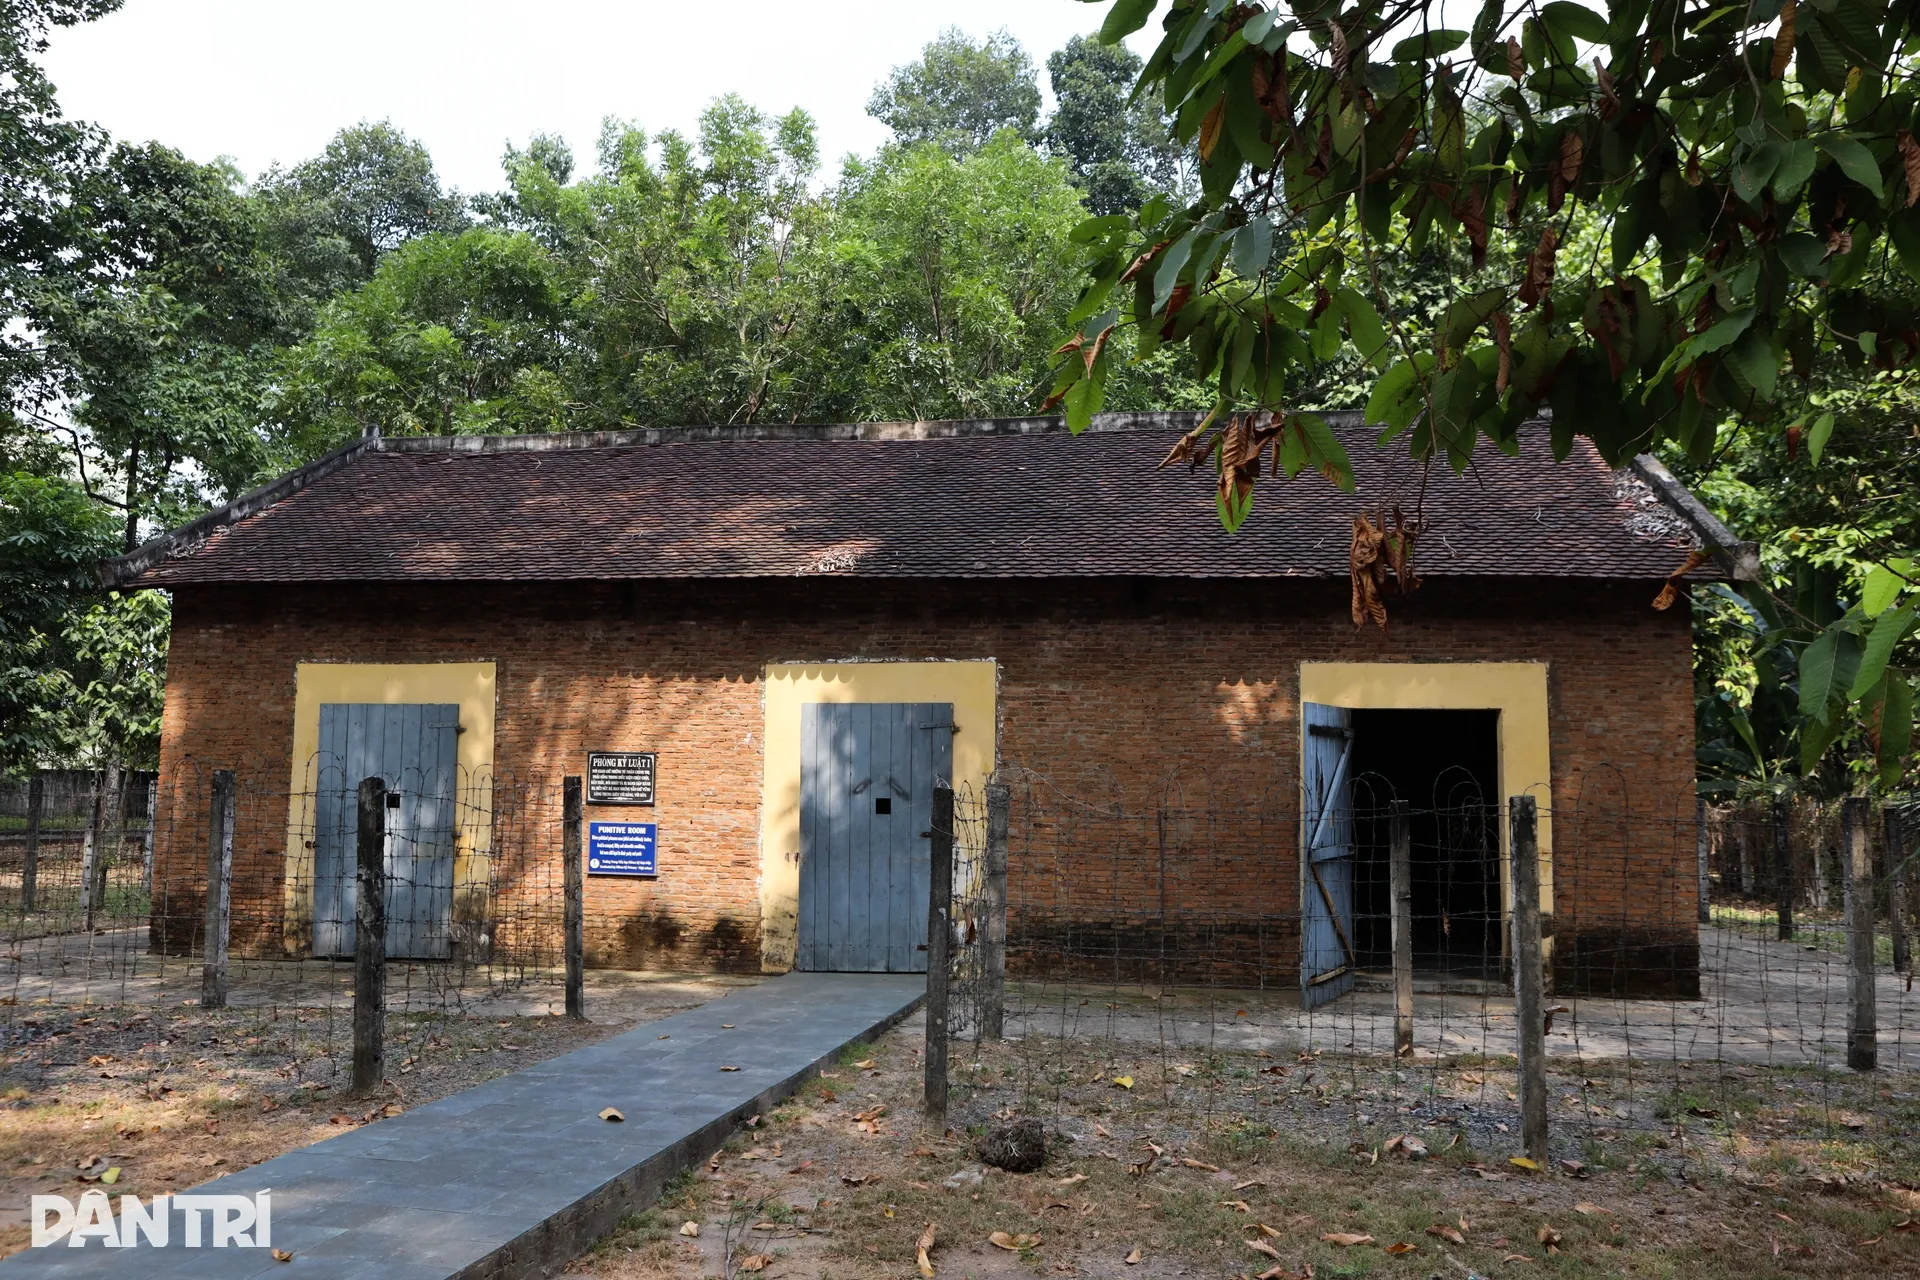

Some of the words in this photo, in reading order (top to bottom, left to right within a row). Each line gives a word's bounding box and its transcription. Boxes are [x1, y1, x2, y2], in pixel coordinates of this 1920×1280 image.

[593, 756, 616, 767] PHÒNG
[617, 755, 627, 767] KỶ
[628, 757, 646, 769] LUẬT
[598, 826, 626, 834] PUNITIVE
